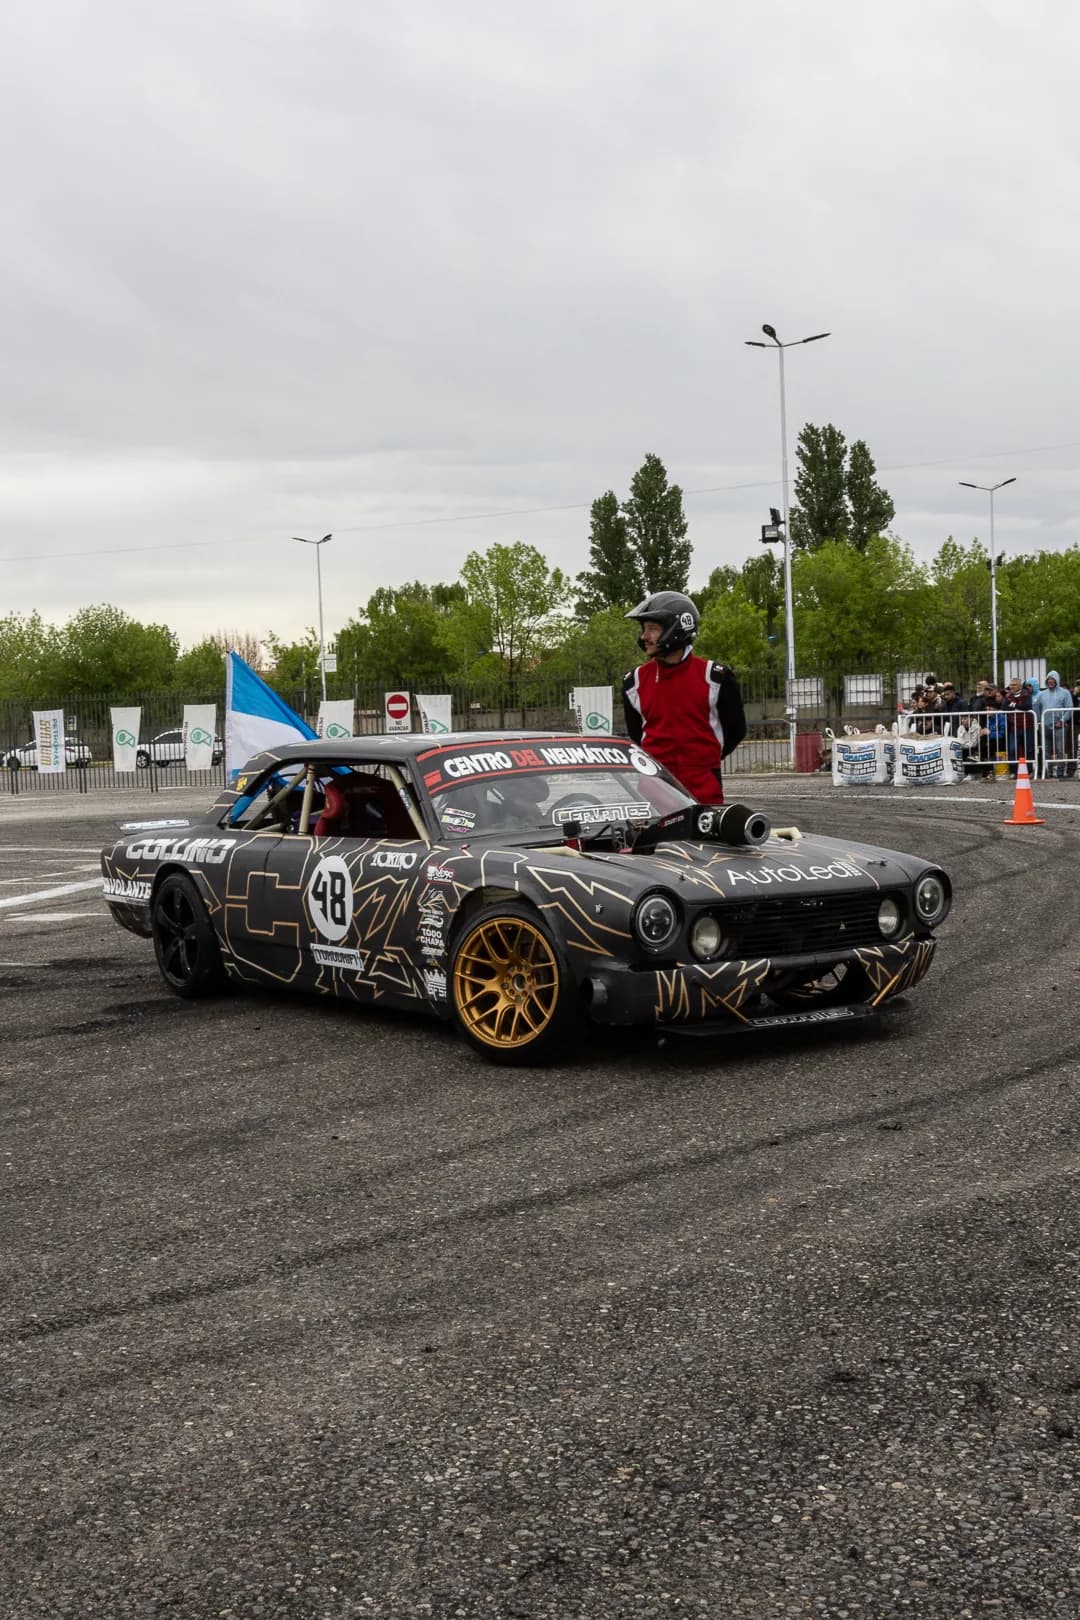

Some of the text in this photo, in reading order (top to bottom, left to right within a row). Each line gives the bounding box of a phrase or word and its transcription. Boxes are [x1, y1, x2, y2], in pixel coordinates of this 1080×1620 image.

[682, 615, 691, 625] 48
[444, 744, 629, 778] CENTRO DEL NEUMÁTICO
[126, 838, 236, 864] COLLINO
[726, 861, 852, 885] AutoLed
[311, 870, 347, 926] 48
[420, 936, 445, 947] CHAPA
[422, 928, 442, 938] TODO
